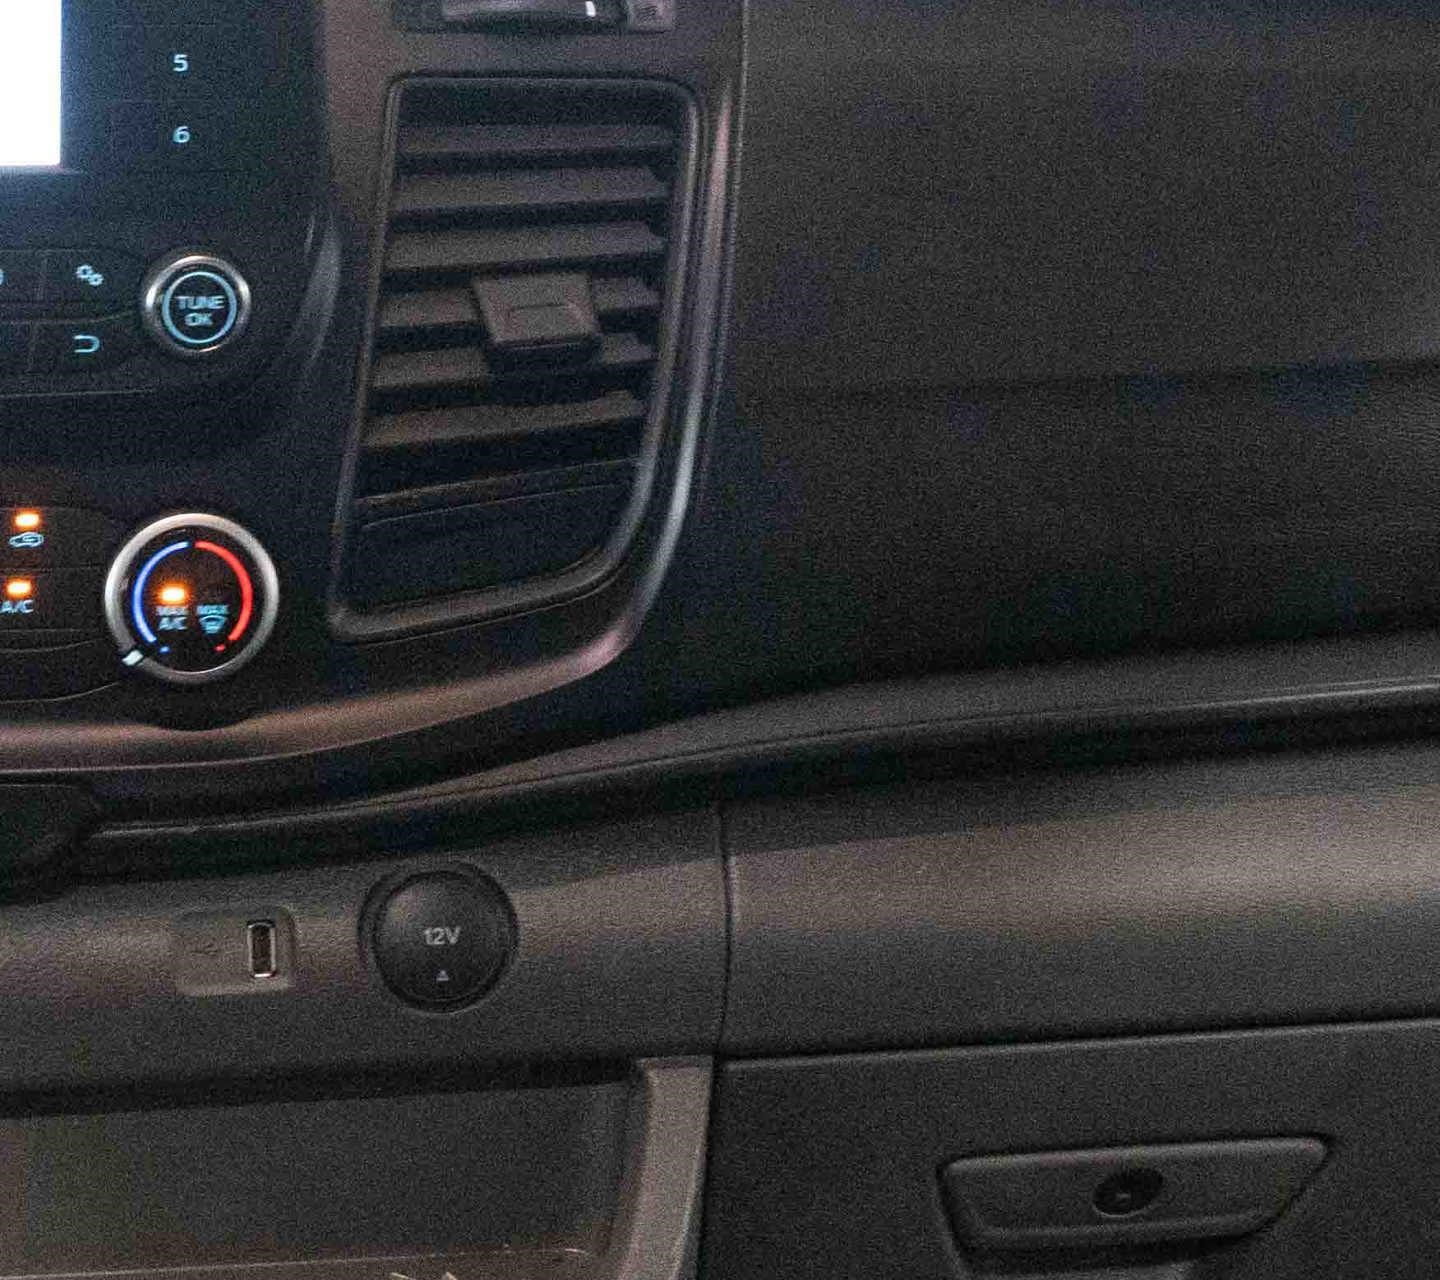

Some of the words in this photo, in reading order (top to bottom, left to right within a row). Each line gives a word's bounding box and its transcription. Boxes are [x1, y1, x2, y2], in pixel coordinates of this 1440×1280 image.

[173, 53, 189, 73] 5
[173, 125, 191, 144] 6
[175, 295, 225, 310] TUNE
[184, 312, 213, 327] OK
[0, 599, 35, 615] A/C
[155, 605, 189, 616] MAX
[158, 616, 189, 631] A/C
[423, 926, 461, 945] 12V
